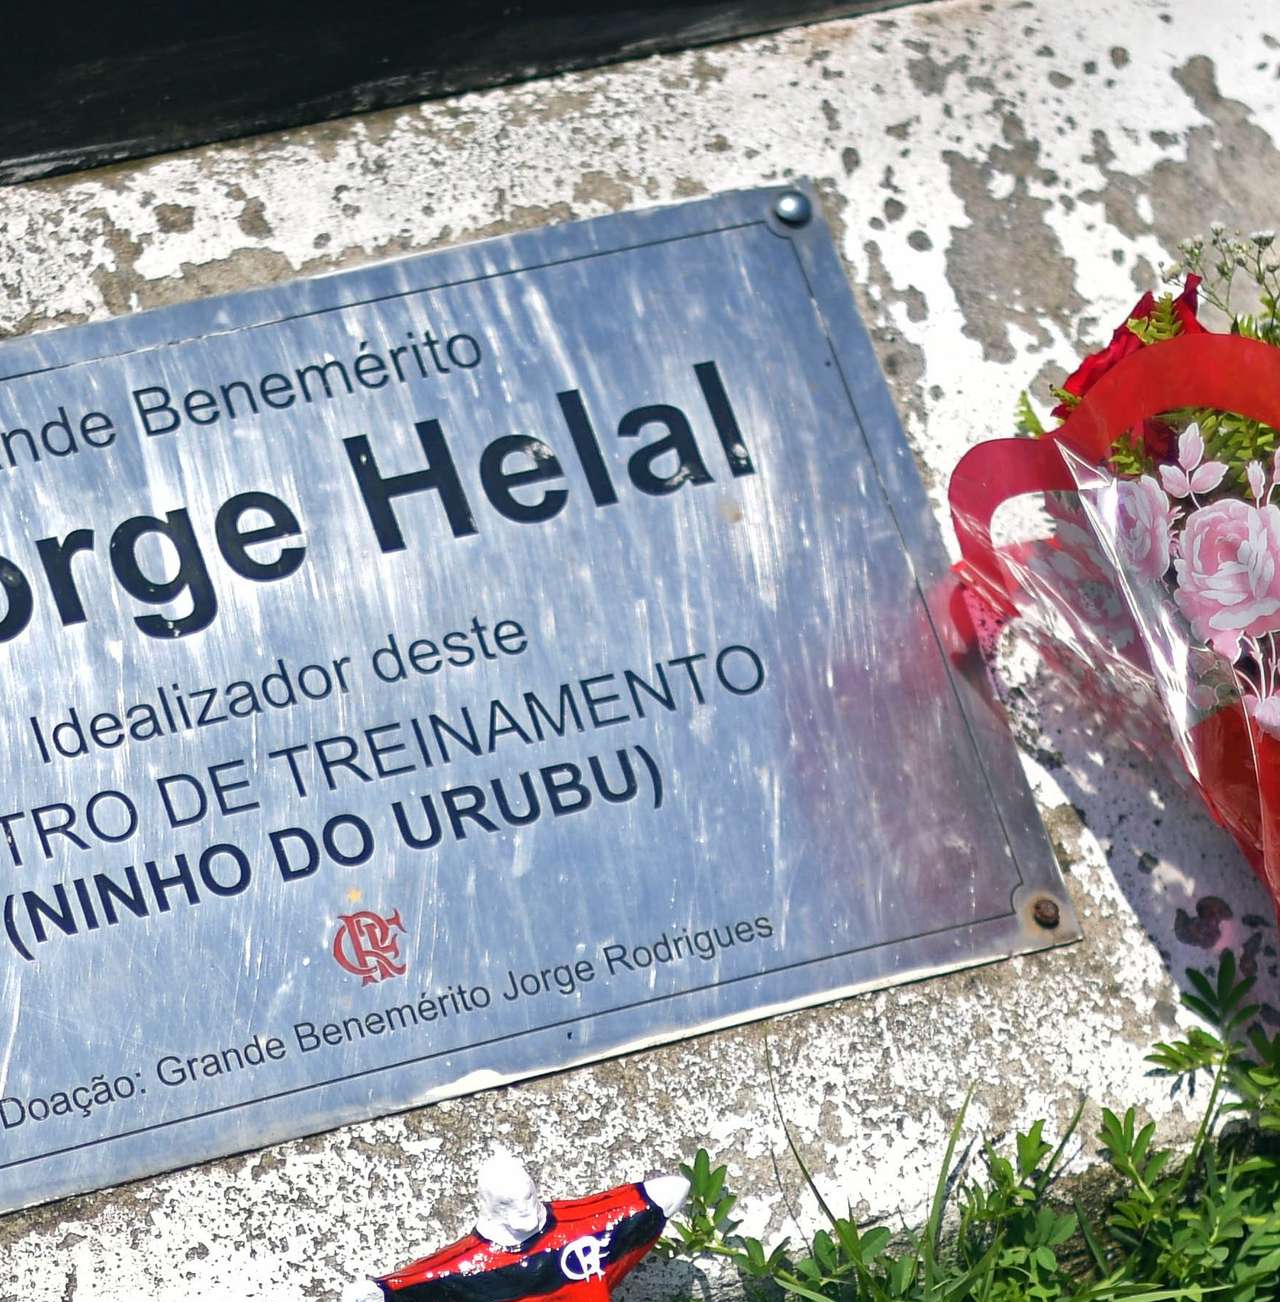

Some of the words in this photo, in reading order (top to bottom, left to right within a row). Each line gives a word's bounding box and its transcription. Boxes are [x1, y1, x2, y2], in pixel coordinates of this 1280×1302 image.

[131, 331, 484, 438] Benemérito
[344, 360, 755, 555] Helal
[29, 656, 352, 764] Idealizador
[372, 613, 528, 686] deste
[157, 760, 261, 828] DE
[268, 643, 768, 804] TREINAMENTO
[3, 841, 252, 961] (NINHO
[268, 813, 375, 882] DO
[392, 744, 666, 850] URUBU)
[155, 1034, 287, 1086] Grande
[293, 982, 491, 1053] Benemérito
[502, 955, 597, 1004] Jorge
[603, 911, 774, 977] Rodrigues
